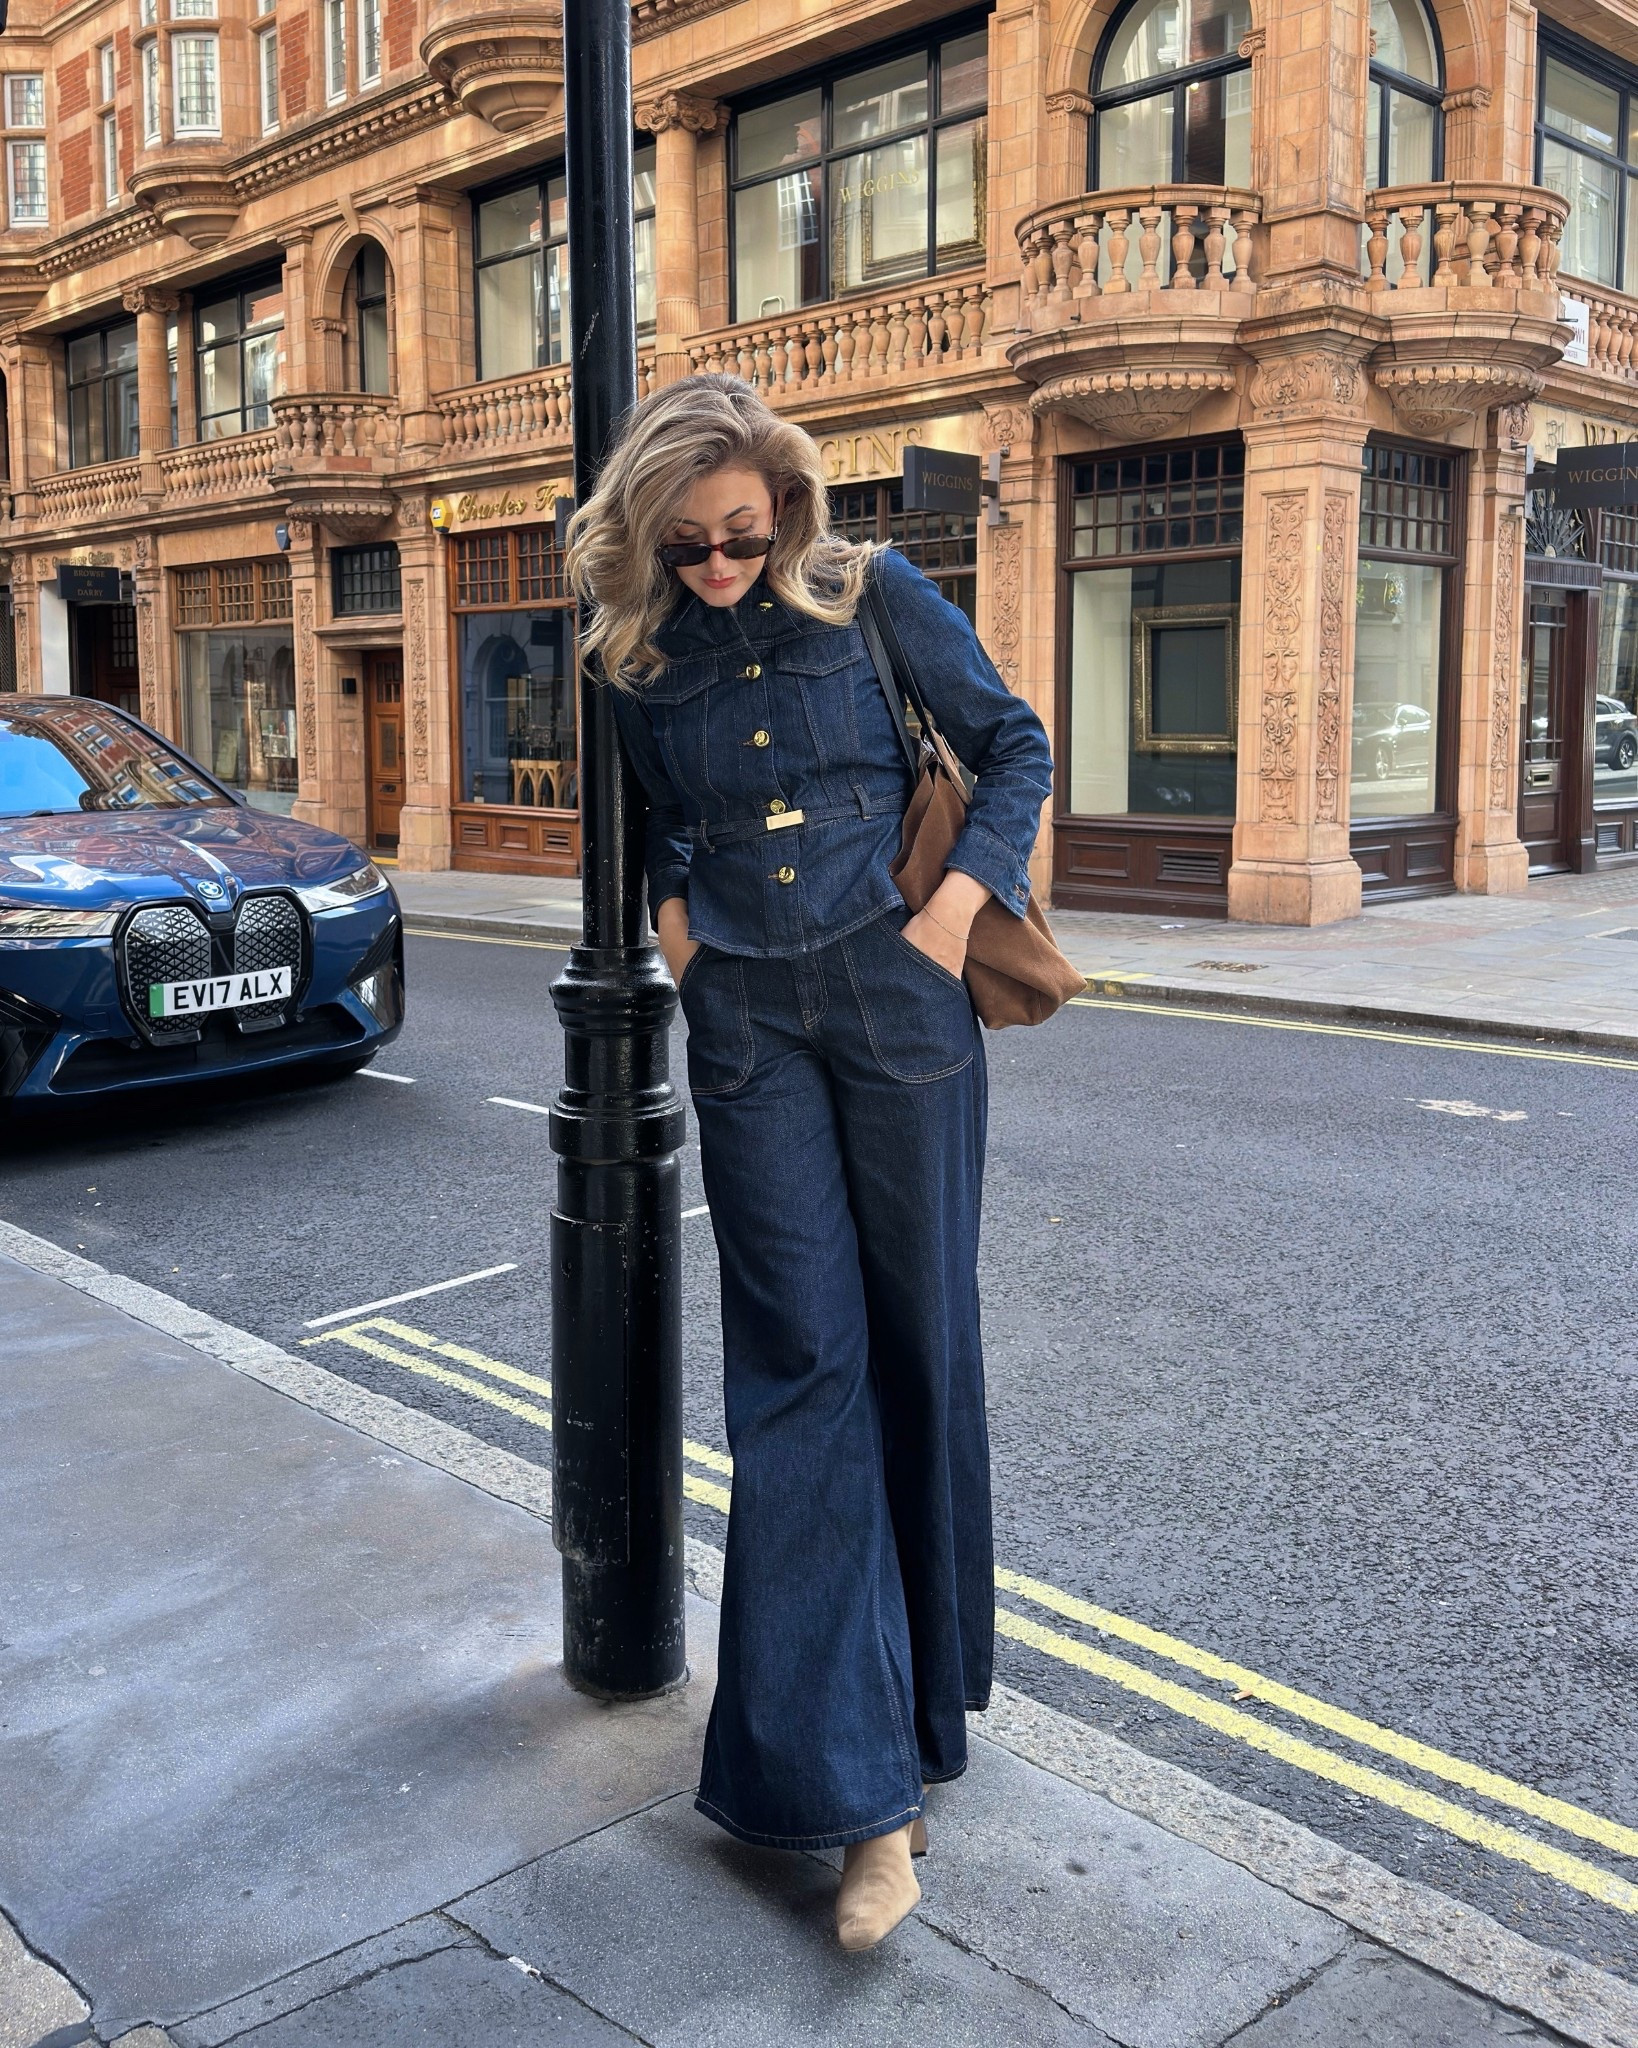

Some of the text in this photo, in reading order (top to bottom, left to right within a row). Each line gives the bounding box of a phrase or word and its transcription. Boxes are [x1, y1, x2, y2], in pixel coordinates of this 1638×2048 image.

[1545, 419, 1566, 451] 31
[922, 470, 973, 491] WIGGINS
[456, 490, 527, 523] Charles
[73, 569, 105, 578] BROWSE
[77, 589, 103, 597] DARBY
[173, 972, 283, 1010] EV17 ALX
